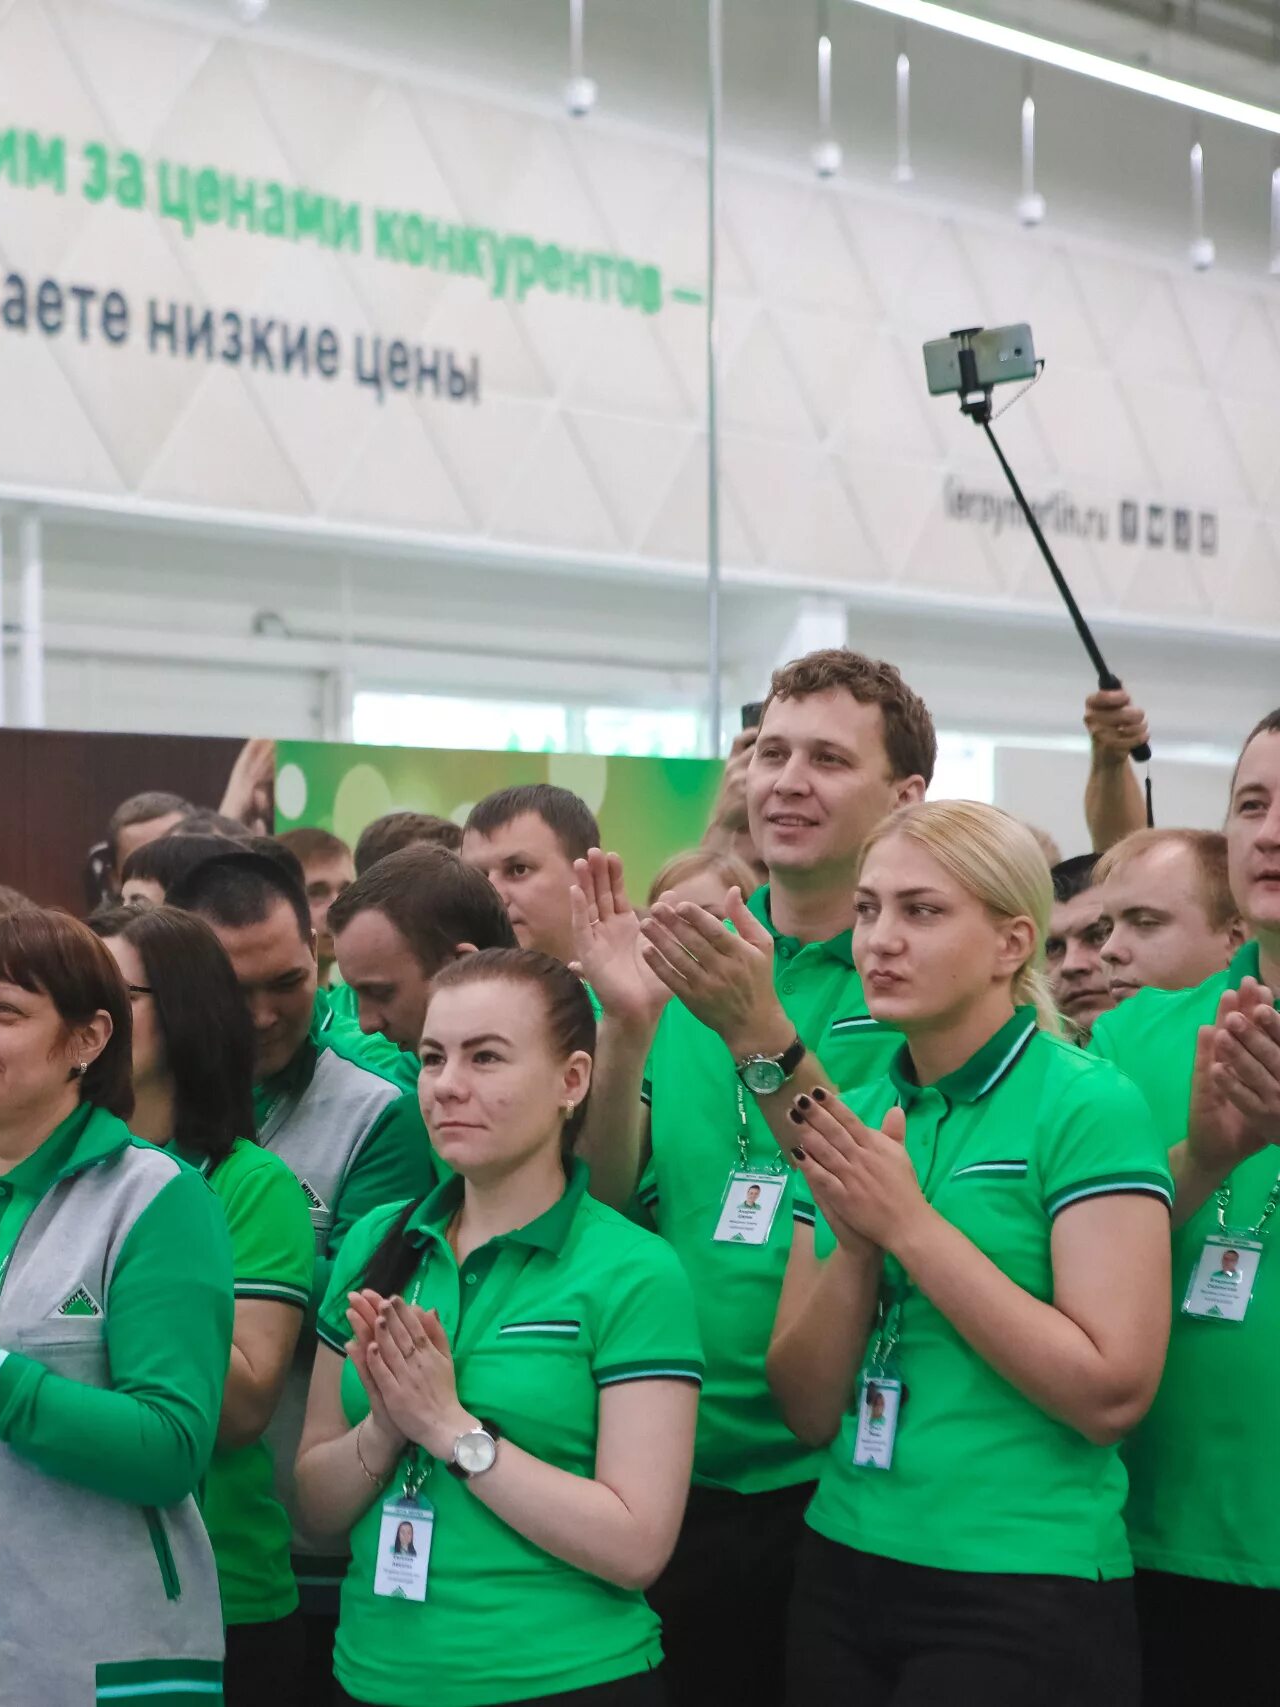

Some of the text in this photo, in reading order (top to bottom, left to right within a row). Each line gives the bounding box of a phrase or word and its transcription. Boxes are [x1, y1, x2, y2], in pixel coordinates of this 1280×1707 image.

[83, 142, 146, 209] за
[158, 160, 362, 250] ценами
[374, 209, 663, 313] конкурентов
[147, 298, 340, 380] низкие
[354, 334, 480, 404] цены
[57, 1287, 100, 1316] LEROY MERLIN
